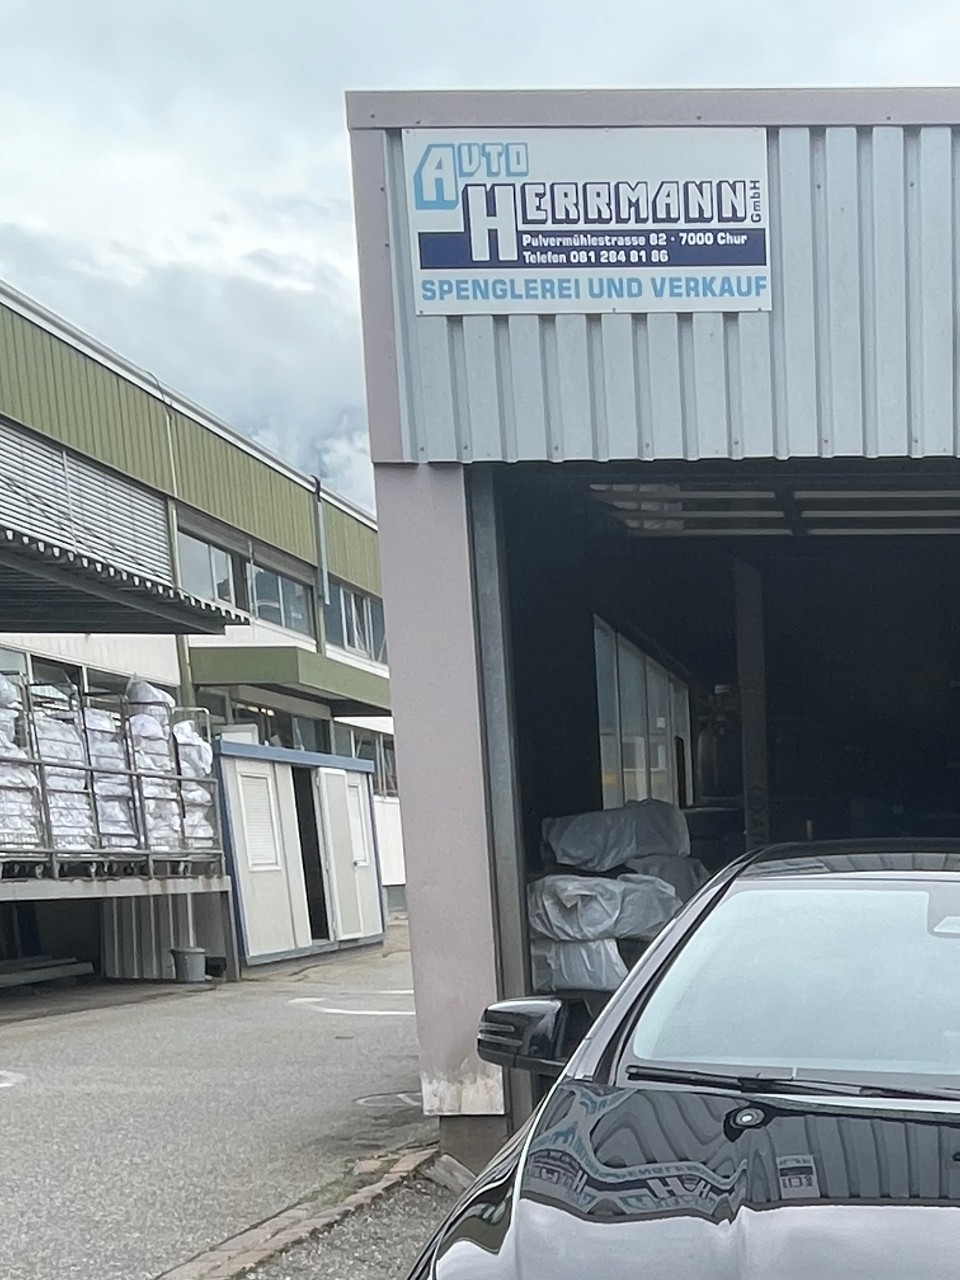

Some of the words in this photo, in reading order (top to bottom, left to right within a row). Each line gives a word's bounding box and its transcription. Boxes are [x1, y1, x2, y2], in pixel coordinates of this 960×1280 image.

[413, 143, 529, 210] AUTO
[750, 180, 762, 223] GmbH
[461, 180, 747, 262] HERRMANN
[522, 234, 646, 247] Pulvermühlestrasse
[679, 232, 714, 246] 7000
[717, 232, 748, 245] Chur
[522, 251, 567, 264] Telefon
[570, 250, 596, 263] 081
[421, 278, 580, 301] SPENGLEREI
[588, 278, 643, 298] UND
[651, 276, 767, 298] VERKAUF
